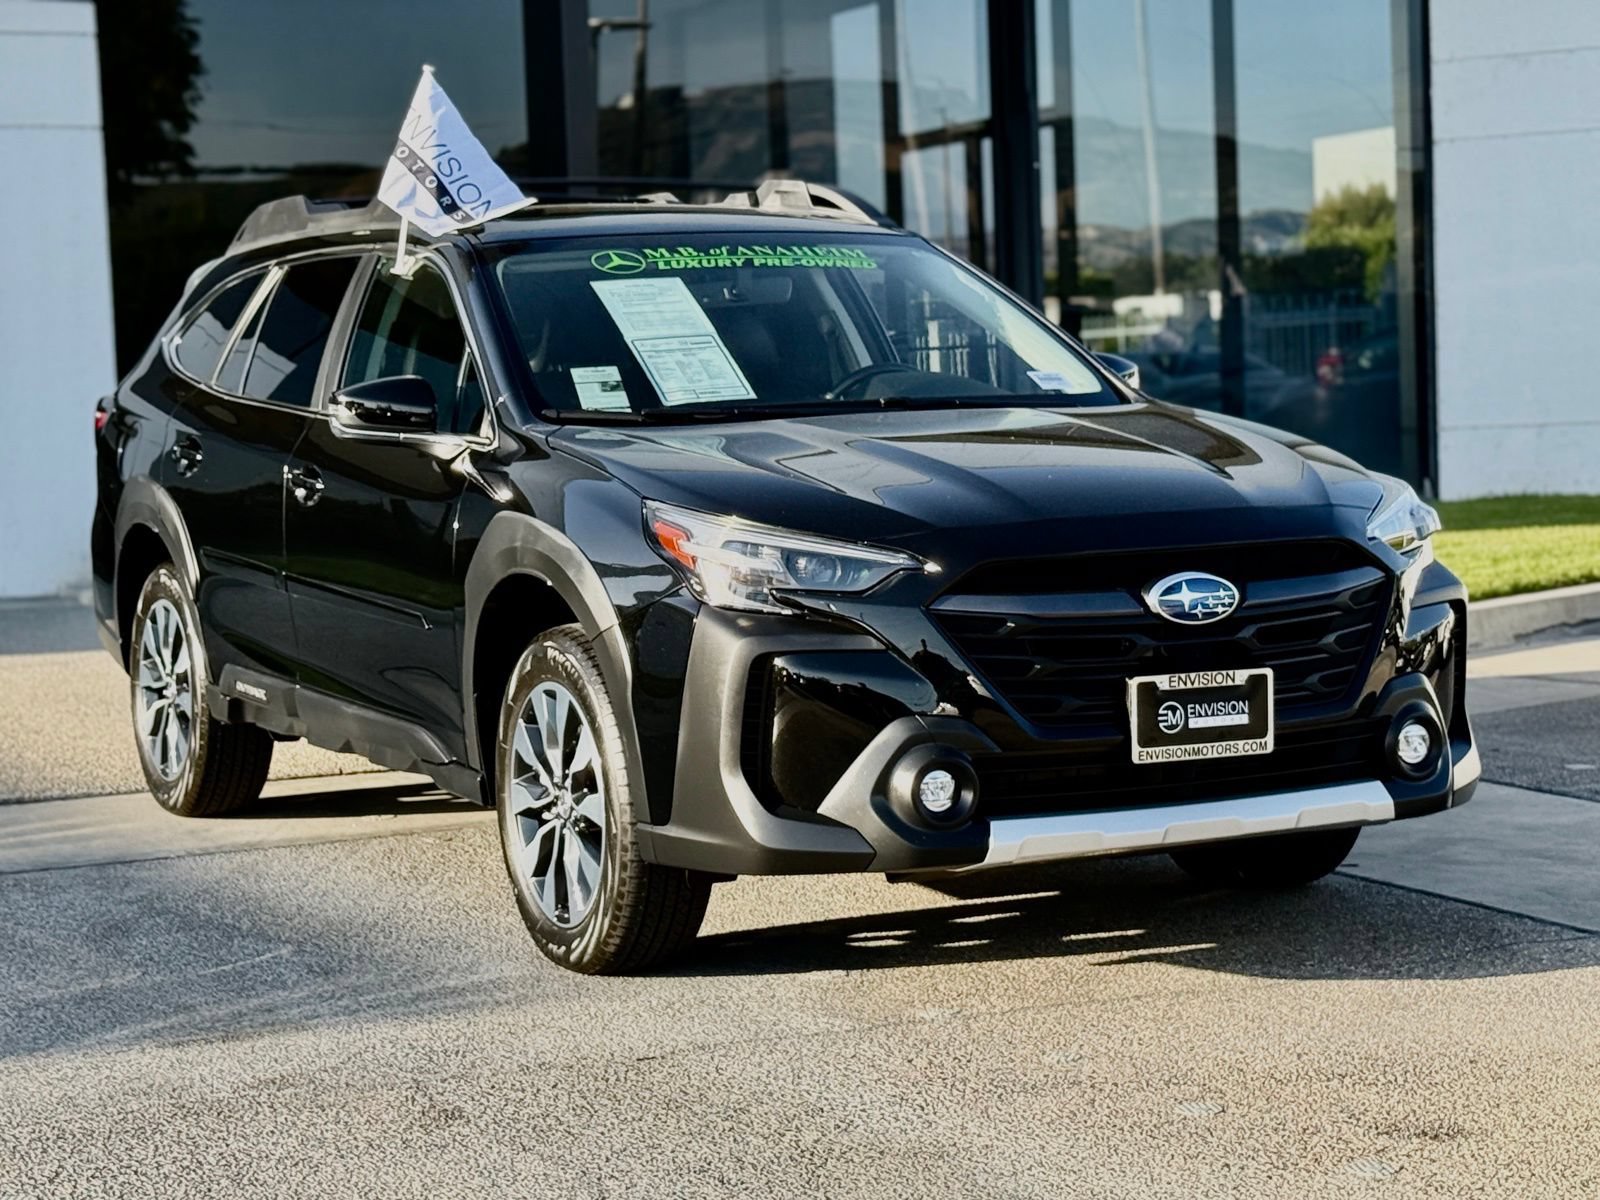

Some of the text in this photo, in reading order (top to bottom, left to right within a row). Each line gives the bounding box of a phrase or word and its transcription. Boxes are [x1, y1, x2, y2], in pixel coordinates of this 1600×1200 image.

[406, 106, 491, 218] NVISION
[396, 146, 467, 220] OTORS
[708, 245, 730, 258] of
[737, 245, 866, 258] ANAHEIM
[658, 257, 877, 270] LUXURY PRE-OWNED
[1168, 671, 1236, 688] ENVISION
[1187, 700, 1249, 717] ENVISION
[1138, 740, 1268, 762] ENVISIONMOTORS.COM
